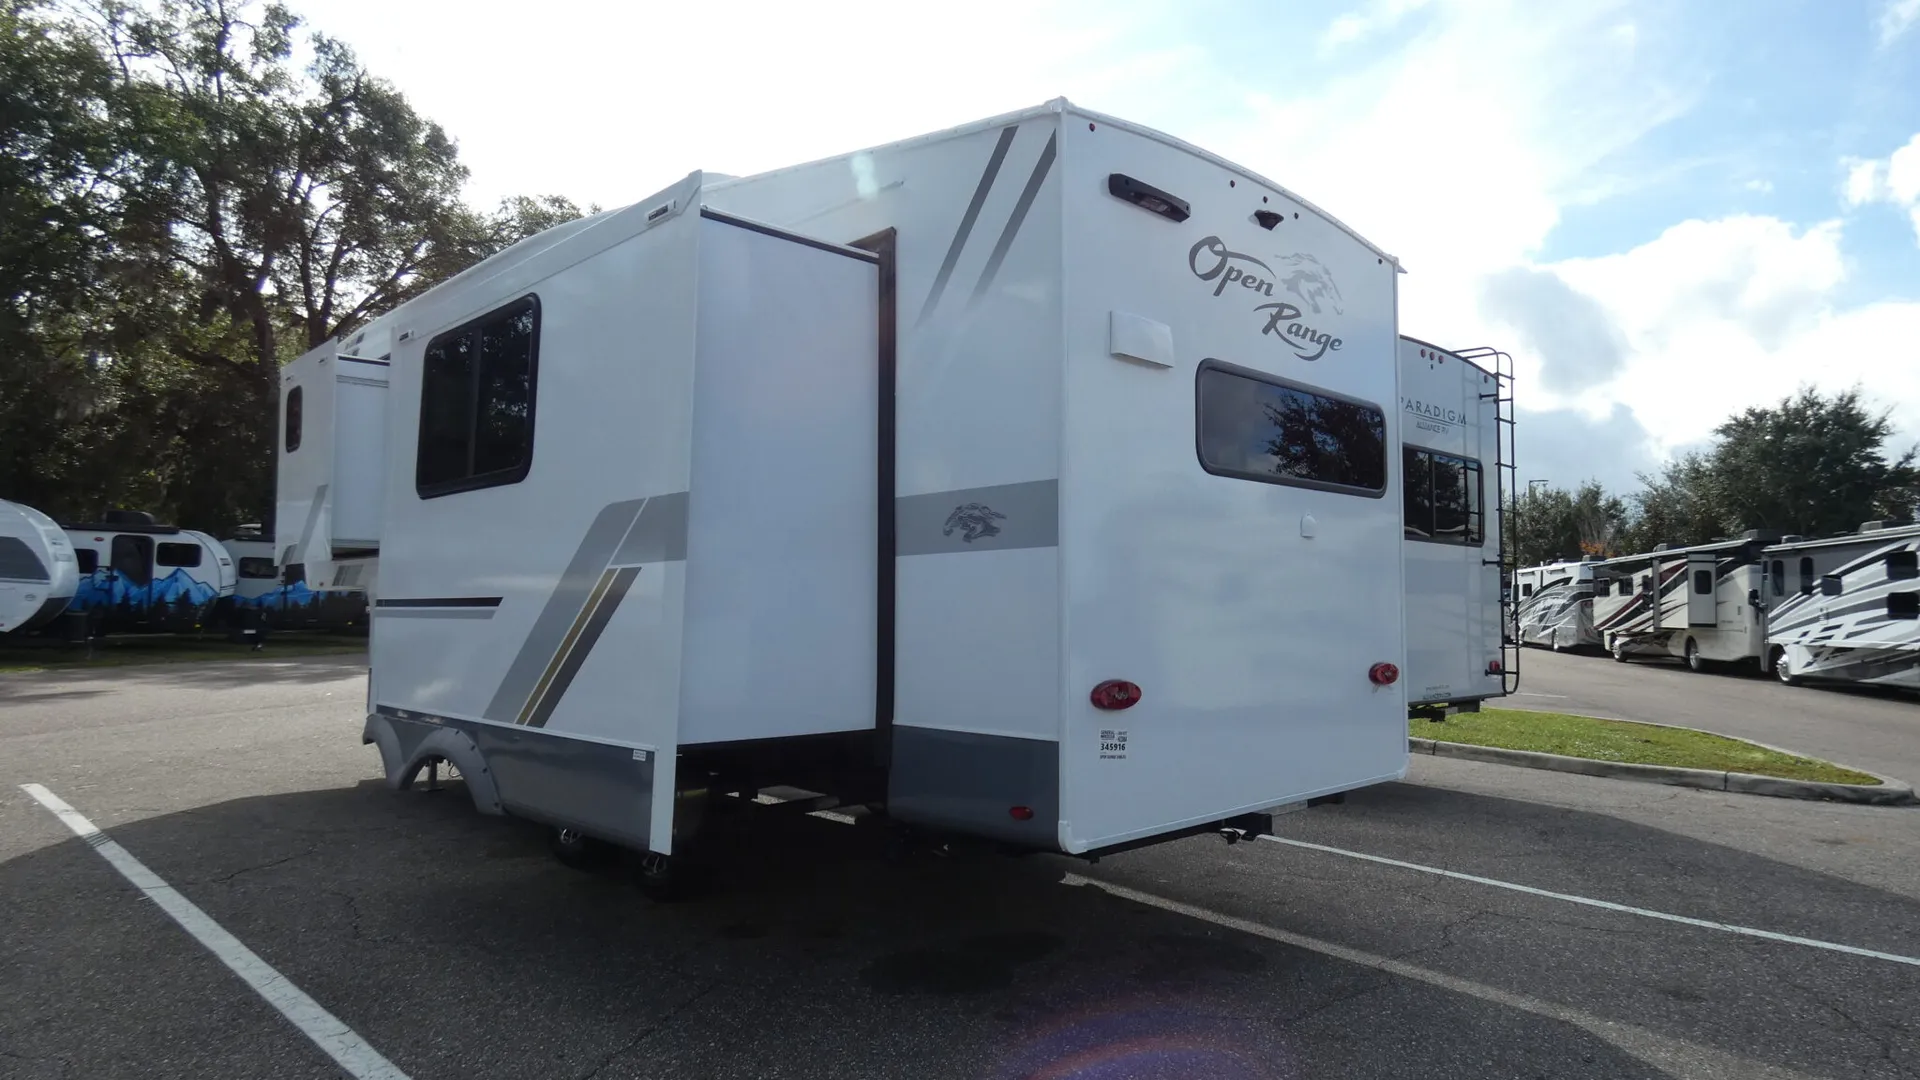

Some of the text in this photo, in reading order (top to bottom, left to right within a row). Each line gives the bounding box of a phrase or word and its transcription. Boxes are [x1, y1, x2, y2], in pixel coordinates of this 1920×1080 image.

[1189, 236, 1276, 297] Open
[1253, 302, 1343, 361] Range
[1100, 743, 1126, 751] 345916
